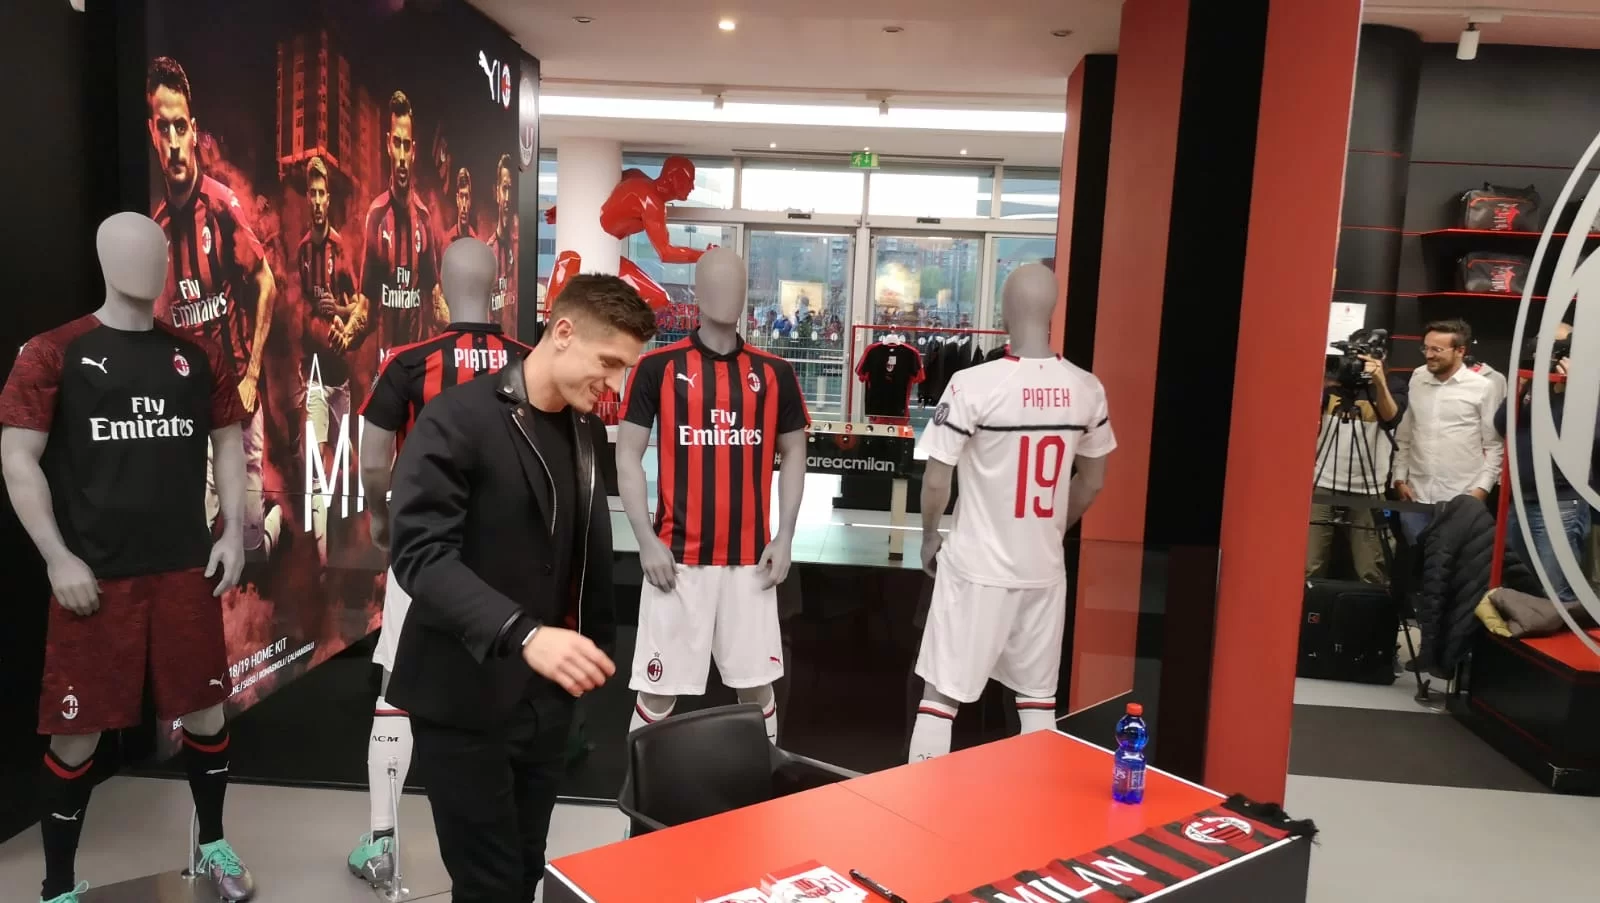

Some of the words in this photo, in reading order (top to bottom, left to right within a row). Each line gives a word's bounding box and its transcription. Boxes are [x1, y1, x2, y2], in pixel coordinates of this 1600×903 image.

[397, 266, 411, 286] Fly
[179, 279, 201, 299] Fly
[382, 282, 421, 309] Emirates
[171, 292, 228, 328] Emirates
[131, 396, 165, 416] Fly
[1022, 387, 1071, 410] PIĄTEK
[89, 413, 194, 441] Emirates
[710, 409, 737, 427] Fly
[679, 424, 762, 446] Emirates
[1014, 435, 1066, 519] 19
[251, 643, 275, 668] HOME
[275, 637, 288, 655] KIT
